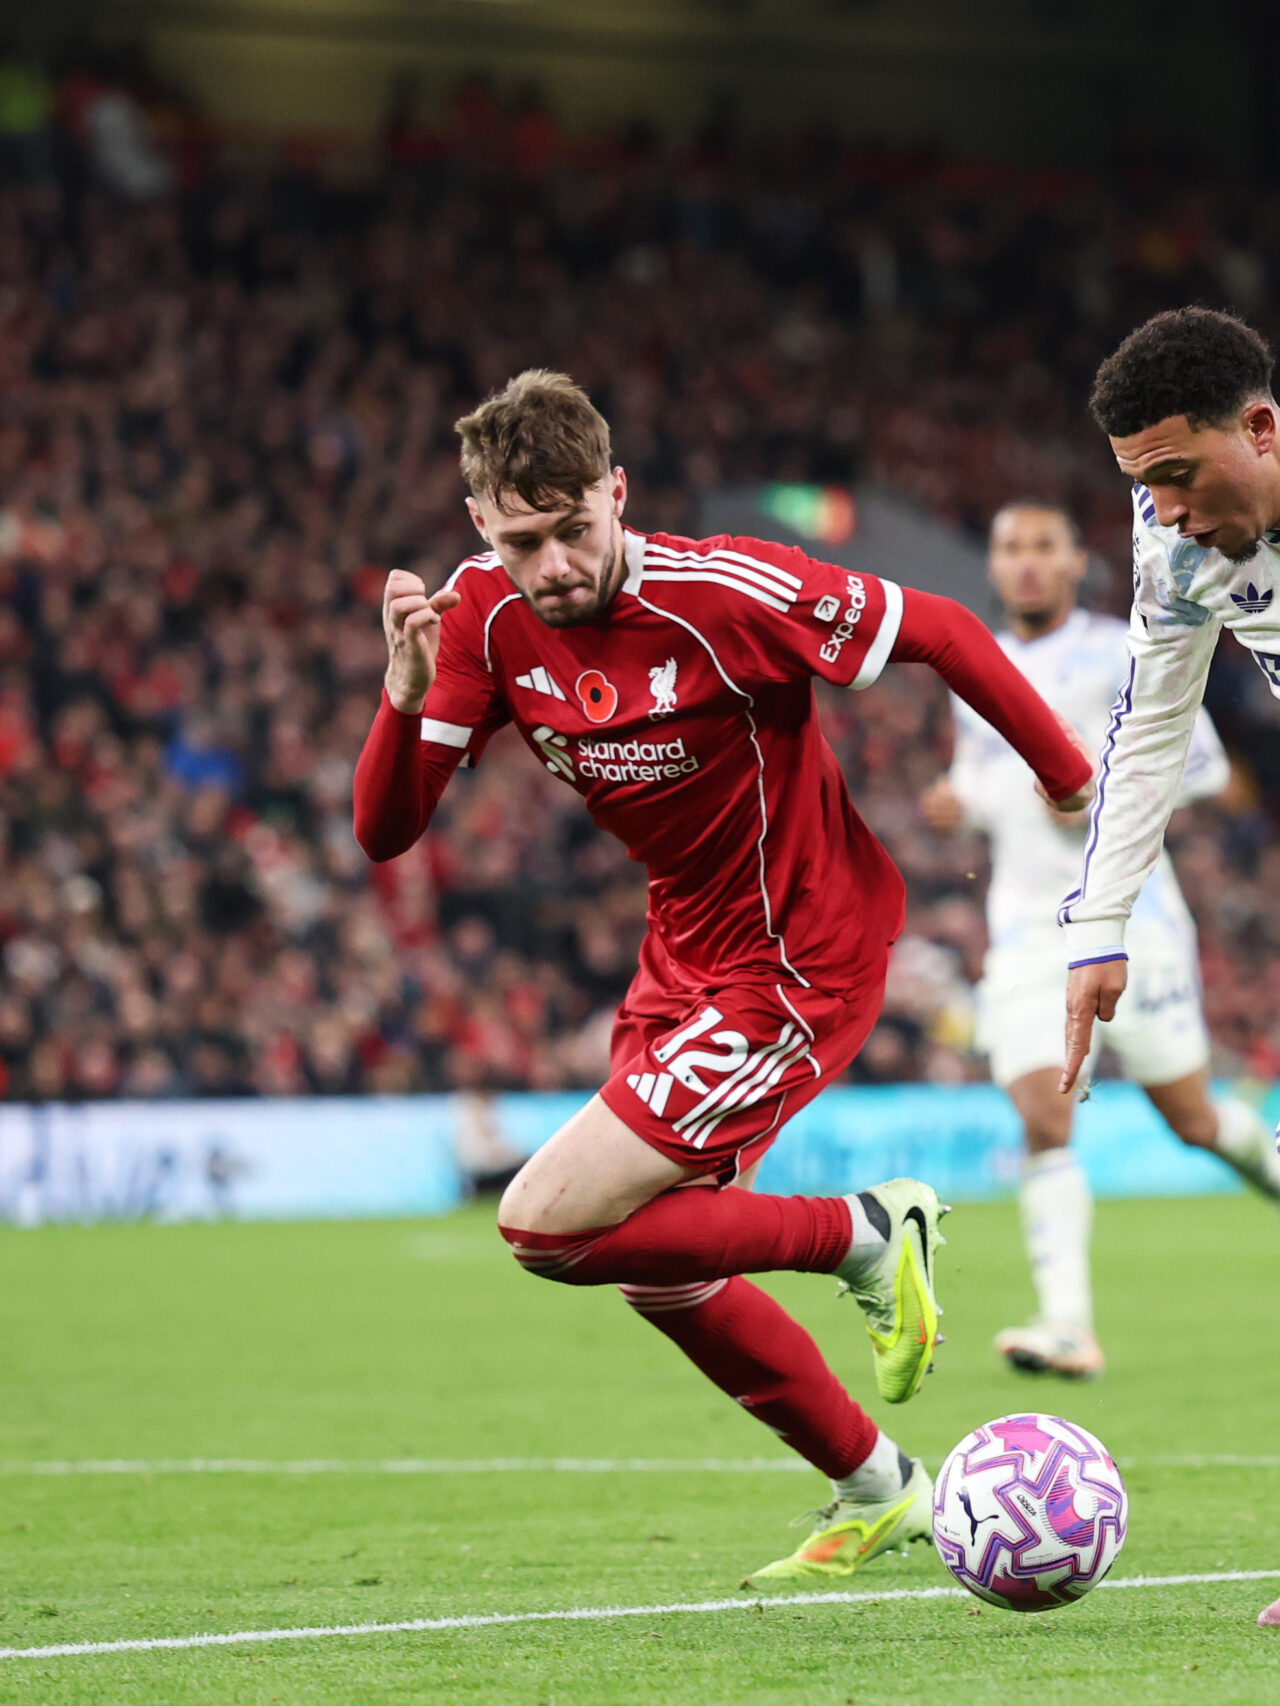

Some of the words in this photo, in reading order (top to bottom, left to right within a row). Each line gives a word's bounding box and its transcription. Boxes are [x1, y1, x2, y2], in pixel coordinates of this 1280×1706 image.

[819, 575, 866, 664] Expedia
[578, 737, 686, 762] standard
[578, 755, 699, 782] chartered
[653, 1006, 749, 1095] 12
